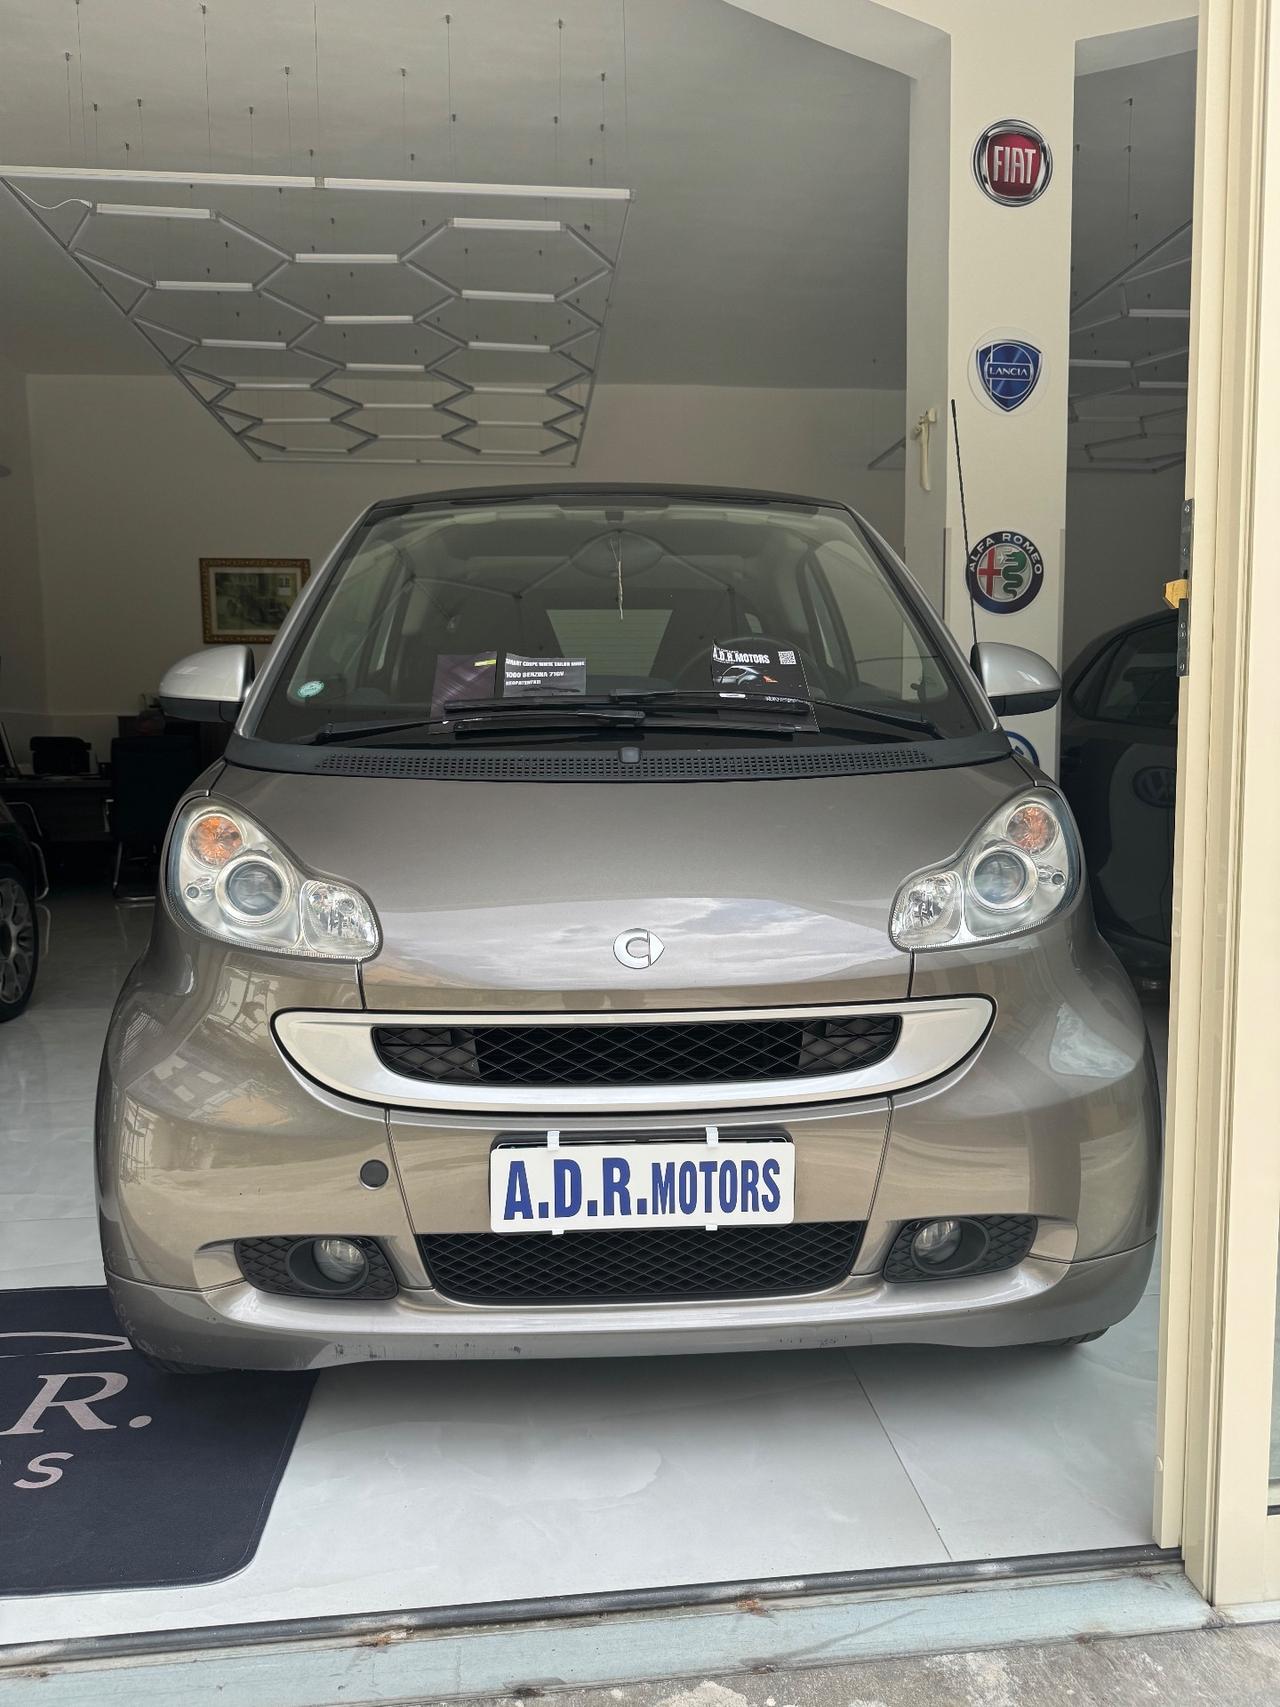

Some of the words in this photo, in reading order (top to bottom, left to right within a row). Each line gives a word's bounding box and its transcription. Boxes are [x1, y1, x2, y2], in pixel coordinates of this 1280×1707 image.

[993, 145, 1037, 184] FIAT
[989, 366, 1028, 376] LANCIA
[969, 537, 995, 573] ALFA
[1002, 533, 1043, 575] ROMEO
